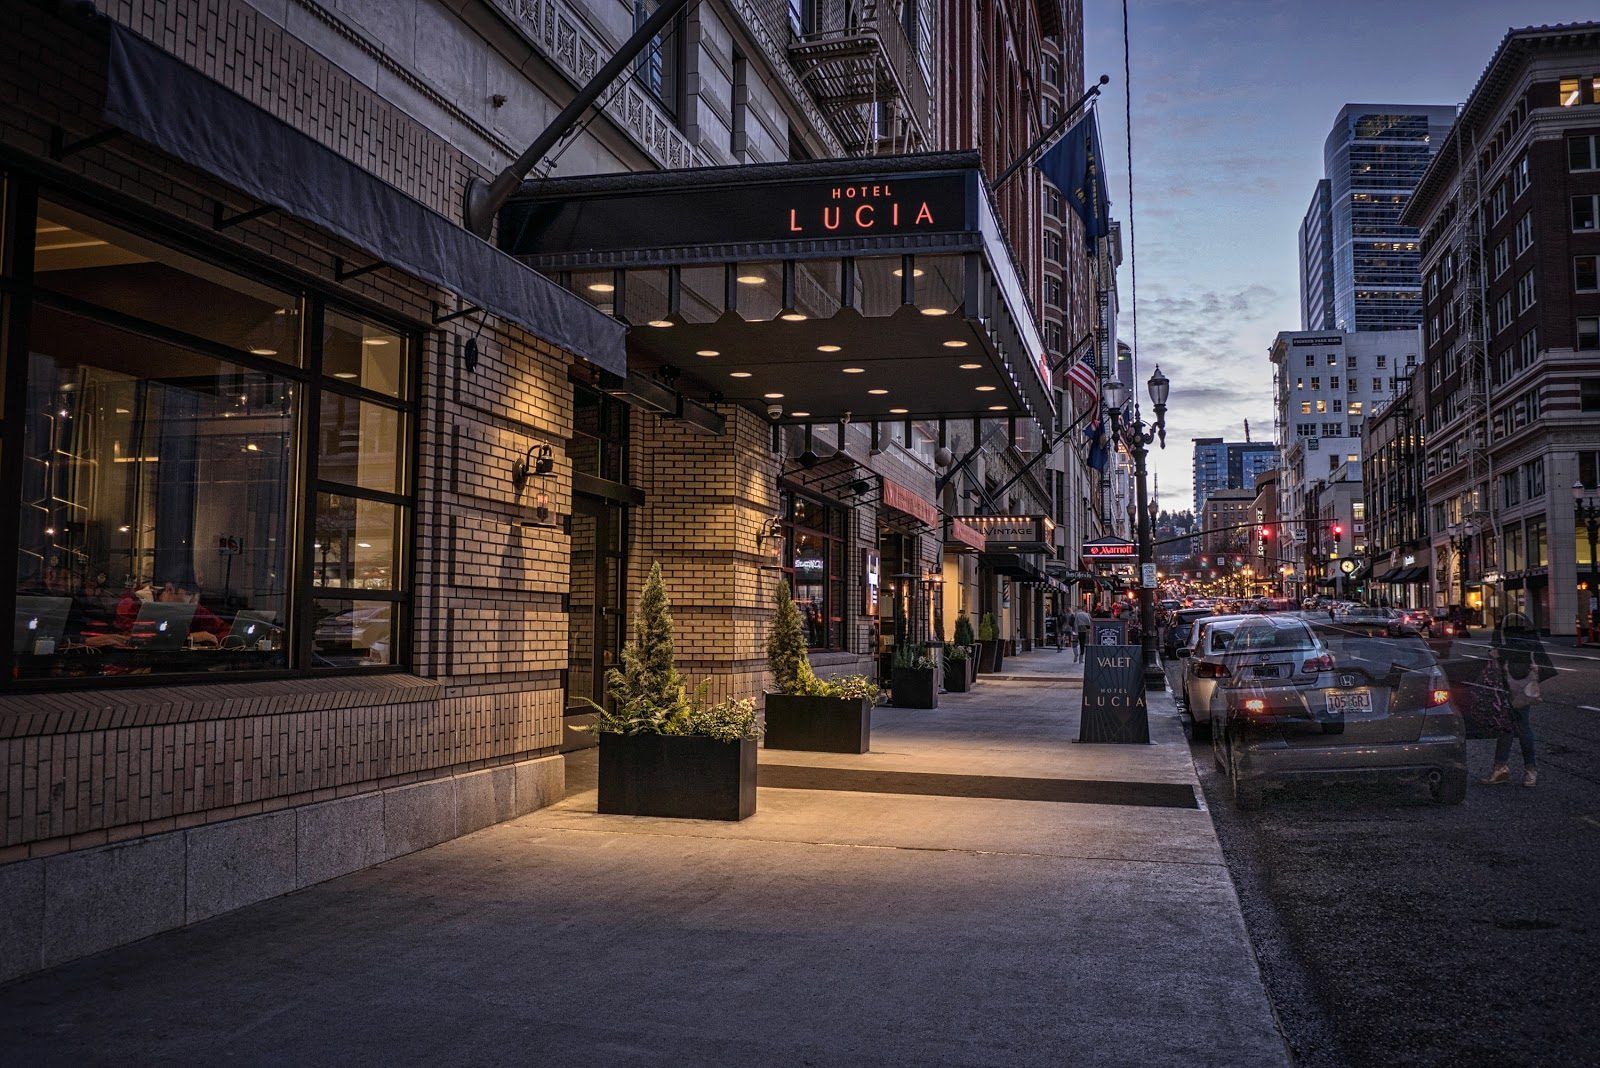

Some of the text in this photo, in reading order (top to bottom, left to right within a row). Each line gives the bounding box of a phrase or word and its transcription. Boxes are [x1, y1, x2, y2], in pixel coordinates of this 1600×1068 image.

[832, 185, 892, 199] HOTEL
[790, 201, 934, 232] LUCIA
[983, 527, 1033, 536] VINTAGE
[1099, 546, 1133, 554] Marriott
[1097, 657, 1131, 668] VALET
[1084, 696, 1144, 707] LUCIA
